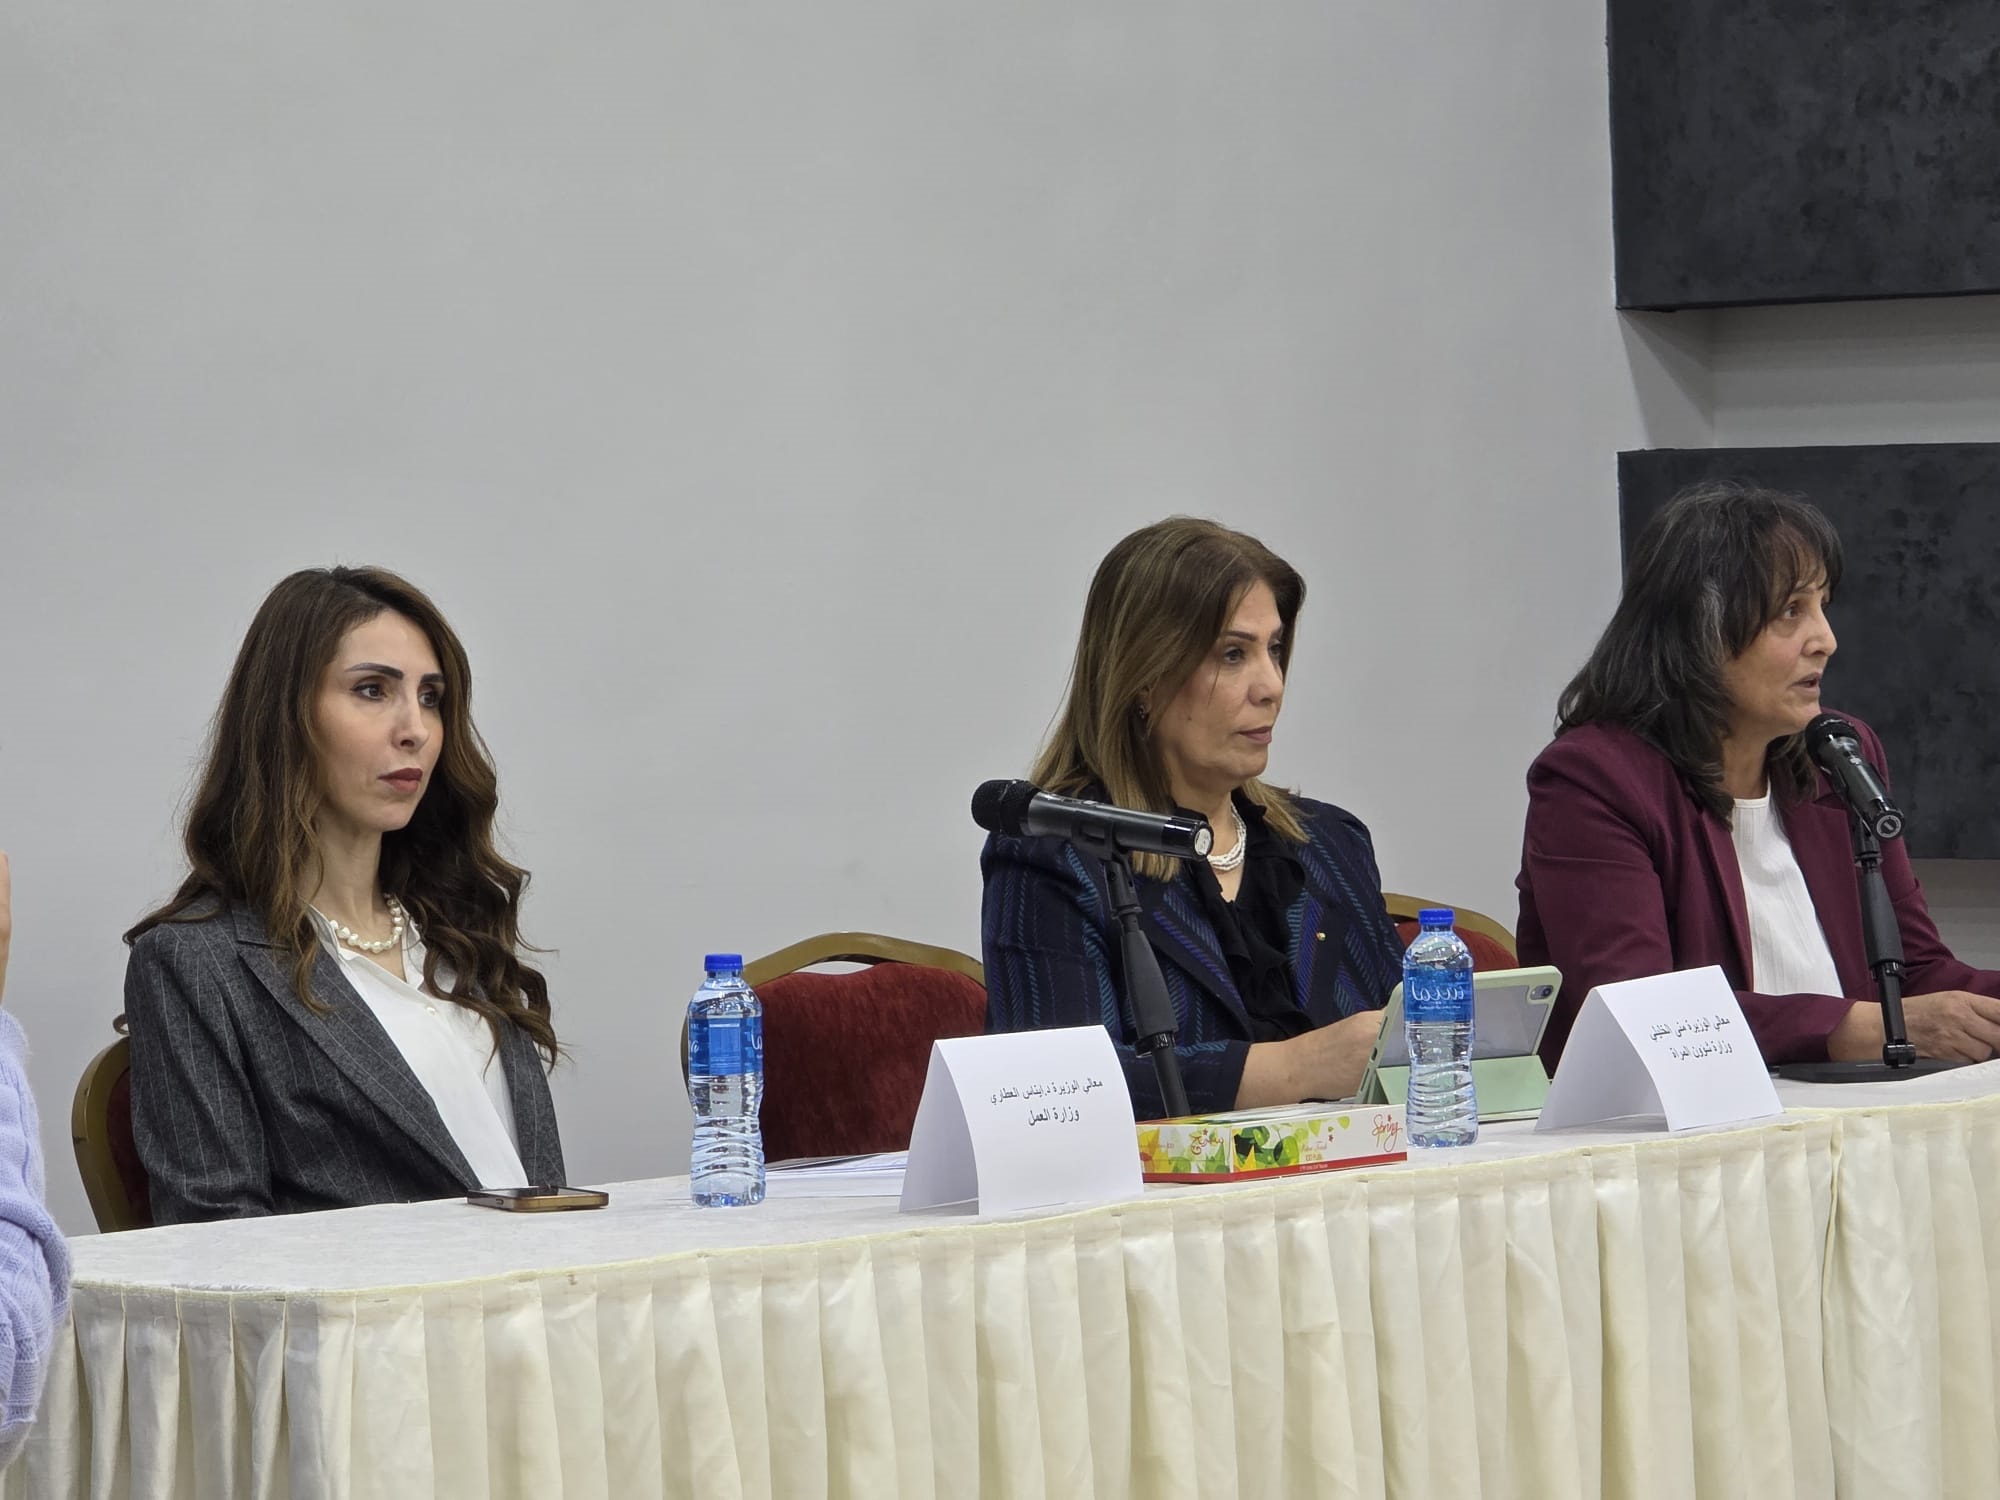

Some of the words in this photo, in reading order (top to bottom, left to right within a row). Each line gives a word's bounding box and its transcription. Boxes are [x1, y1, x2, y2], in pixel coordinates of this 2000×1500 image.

[1684, 1016, 1710, 1033] الوزيرة
[1713, 1015, 1730, 1032] معالي
[1711, 1040, 1732, 1055] وزارة
[1052, 1080, 1080, 1096] الوزيرة
[1083, 1078, 1103, 1094] معالي
[991, 1087, 1019, 1105] العطاري
[1028, 1108, 1050, 1126] العمل
[1053, 1106, 1080, 1123] وزارة
[1372, 1113, 1403, 1152] Spring
